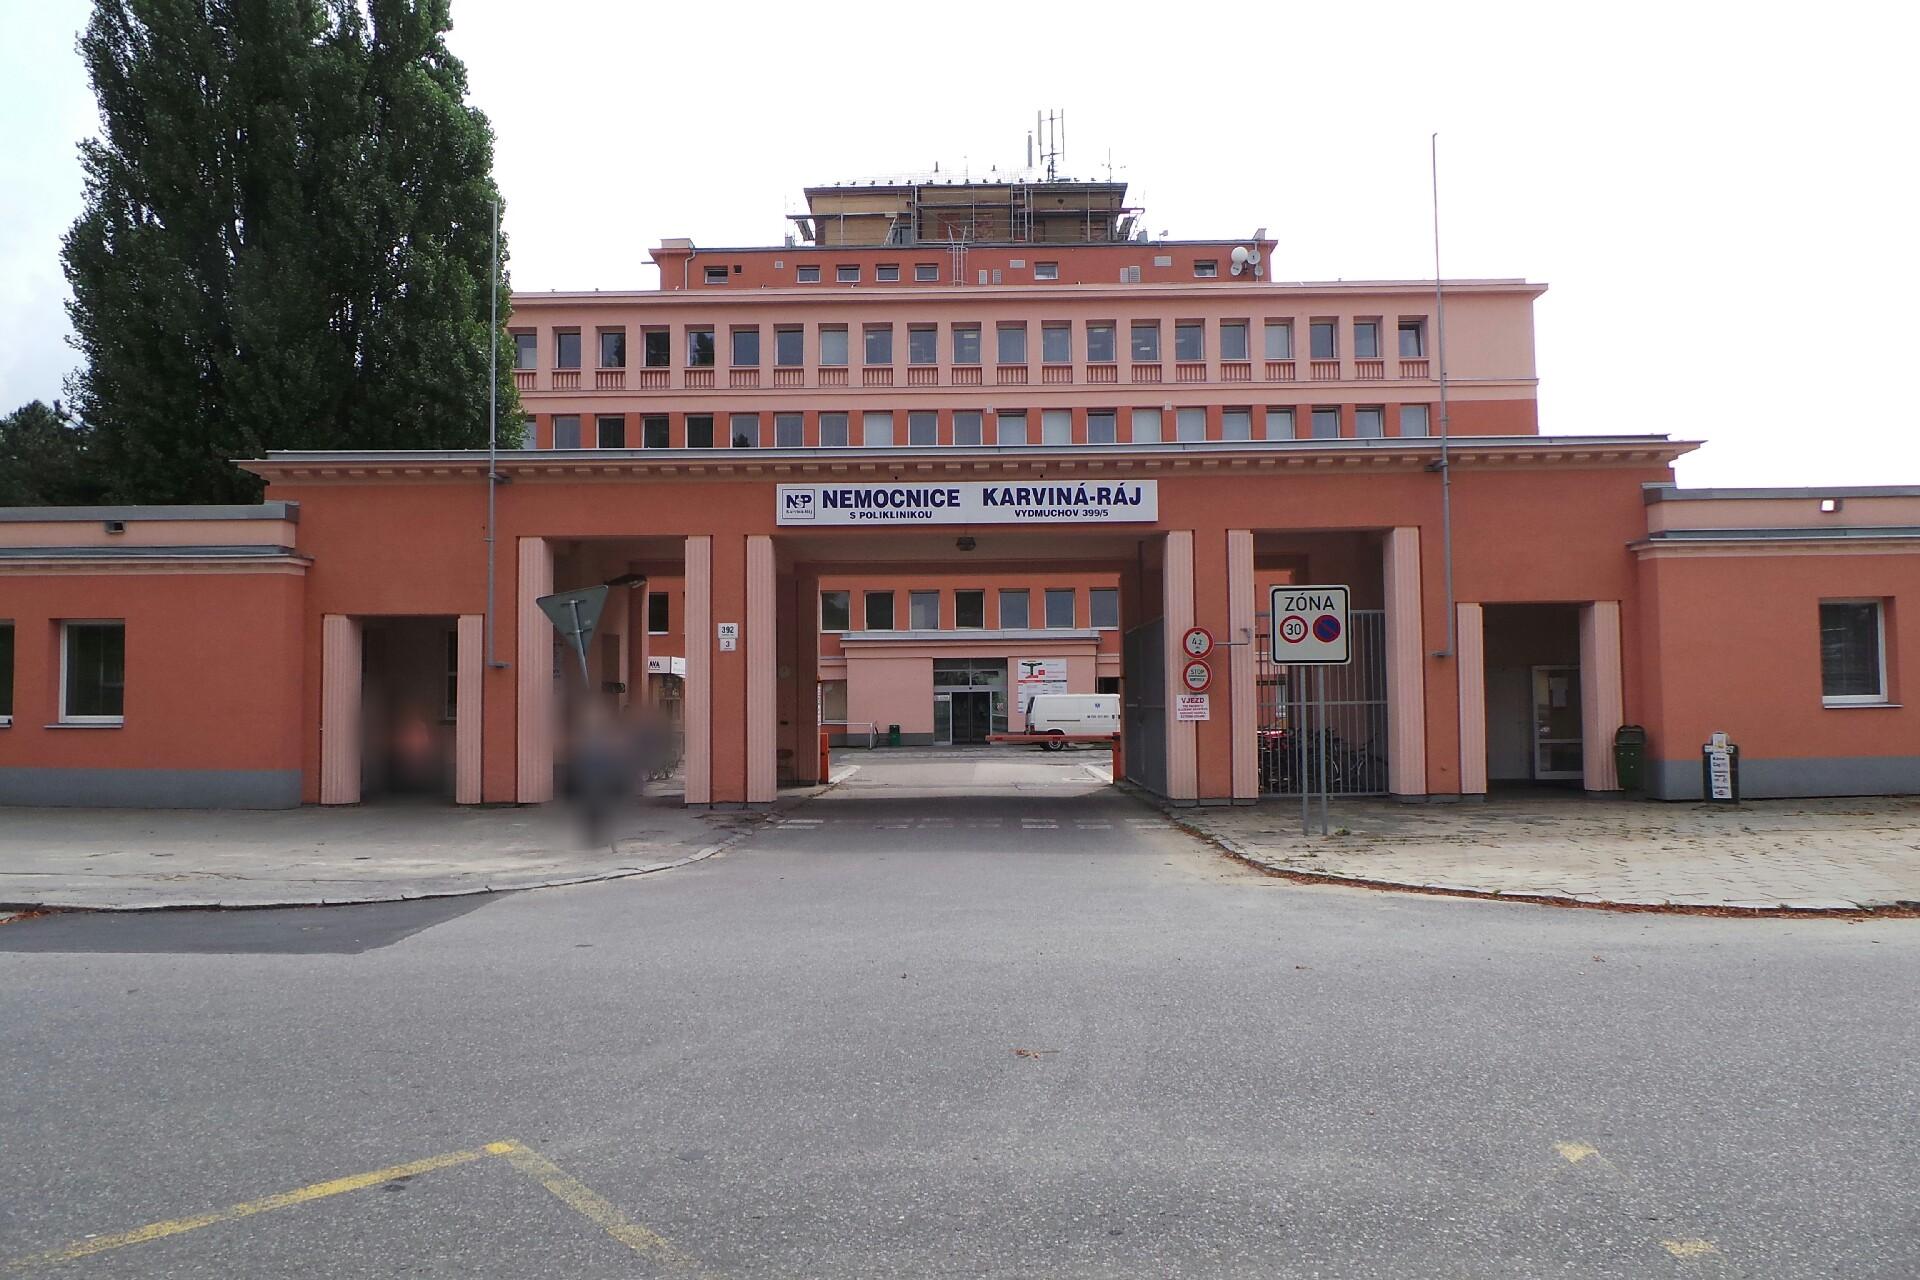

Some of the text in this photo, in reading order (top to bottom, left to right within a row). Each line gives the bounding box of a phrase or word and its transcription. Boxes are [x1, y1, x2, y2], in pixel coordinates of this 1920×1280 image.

[822, 482, 1142, 509] NEMOCNICE KARVINÁ-RÁJ
[850, 511, 933, 520] S POLIKLINIKOU
[1014, 509, 1109, 518] VYDMUCHOV 399/5
[1284, 592, 1336, 612] ZÓNA
[1286, 623, 1302, 636] 30
[725, 640, 730, 648] 3
